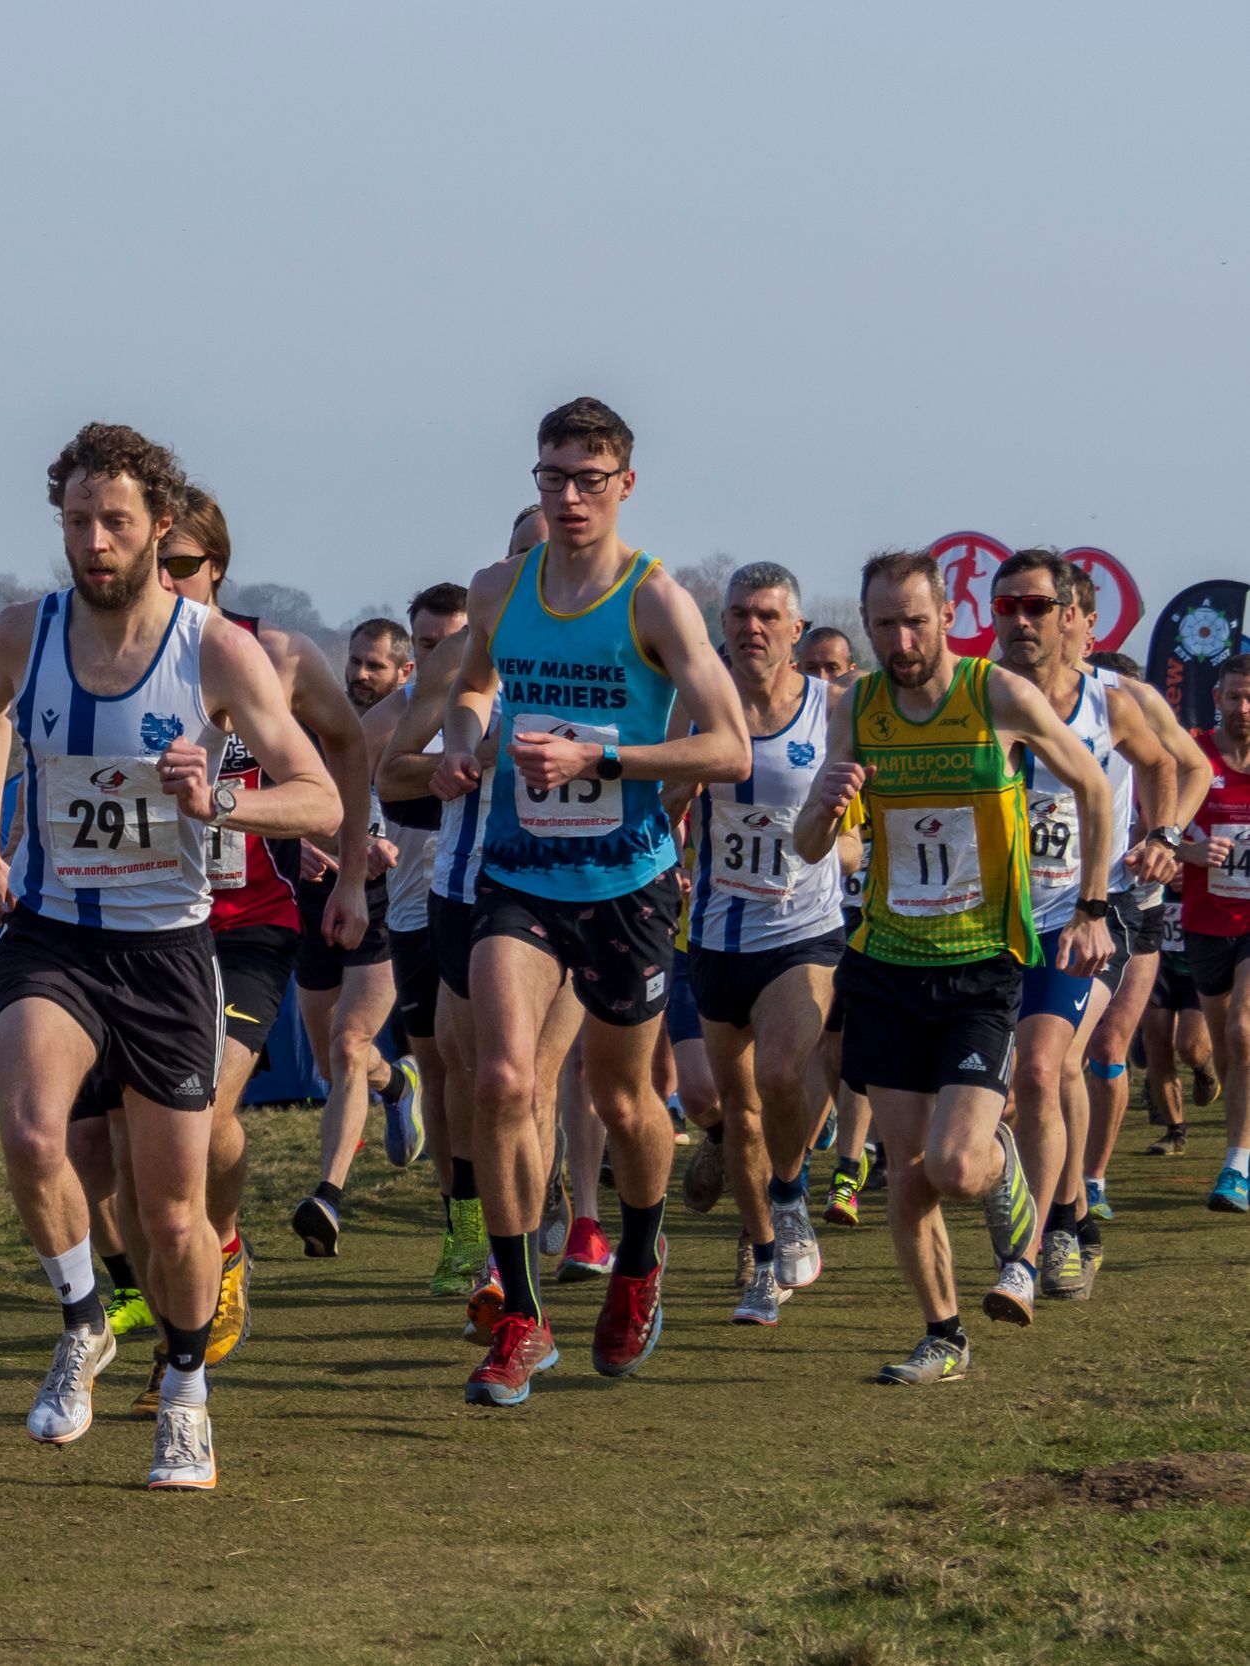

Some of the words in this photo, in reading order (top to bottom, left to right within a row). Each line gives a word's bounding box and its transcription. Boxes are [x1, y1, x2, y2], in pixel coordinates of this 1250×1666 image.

[539, 661, 627, 683] MARSKE
[866, 752, 975, 772] HARTLEPOOL
[68, 797, 150, 850] 291
[1030, 822, 1070, 859] 09
[724, 833, 782, 876] 311
[917, 843, 949, 885] 11
[57, 859, 178, 876] www.northernrunner.com
[958, 1063, 986, 1071] adidas
[174, 1087, 204, 1096] adidas
